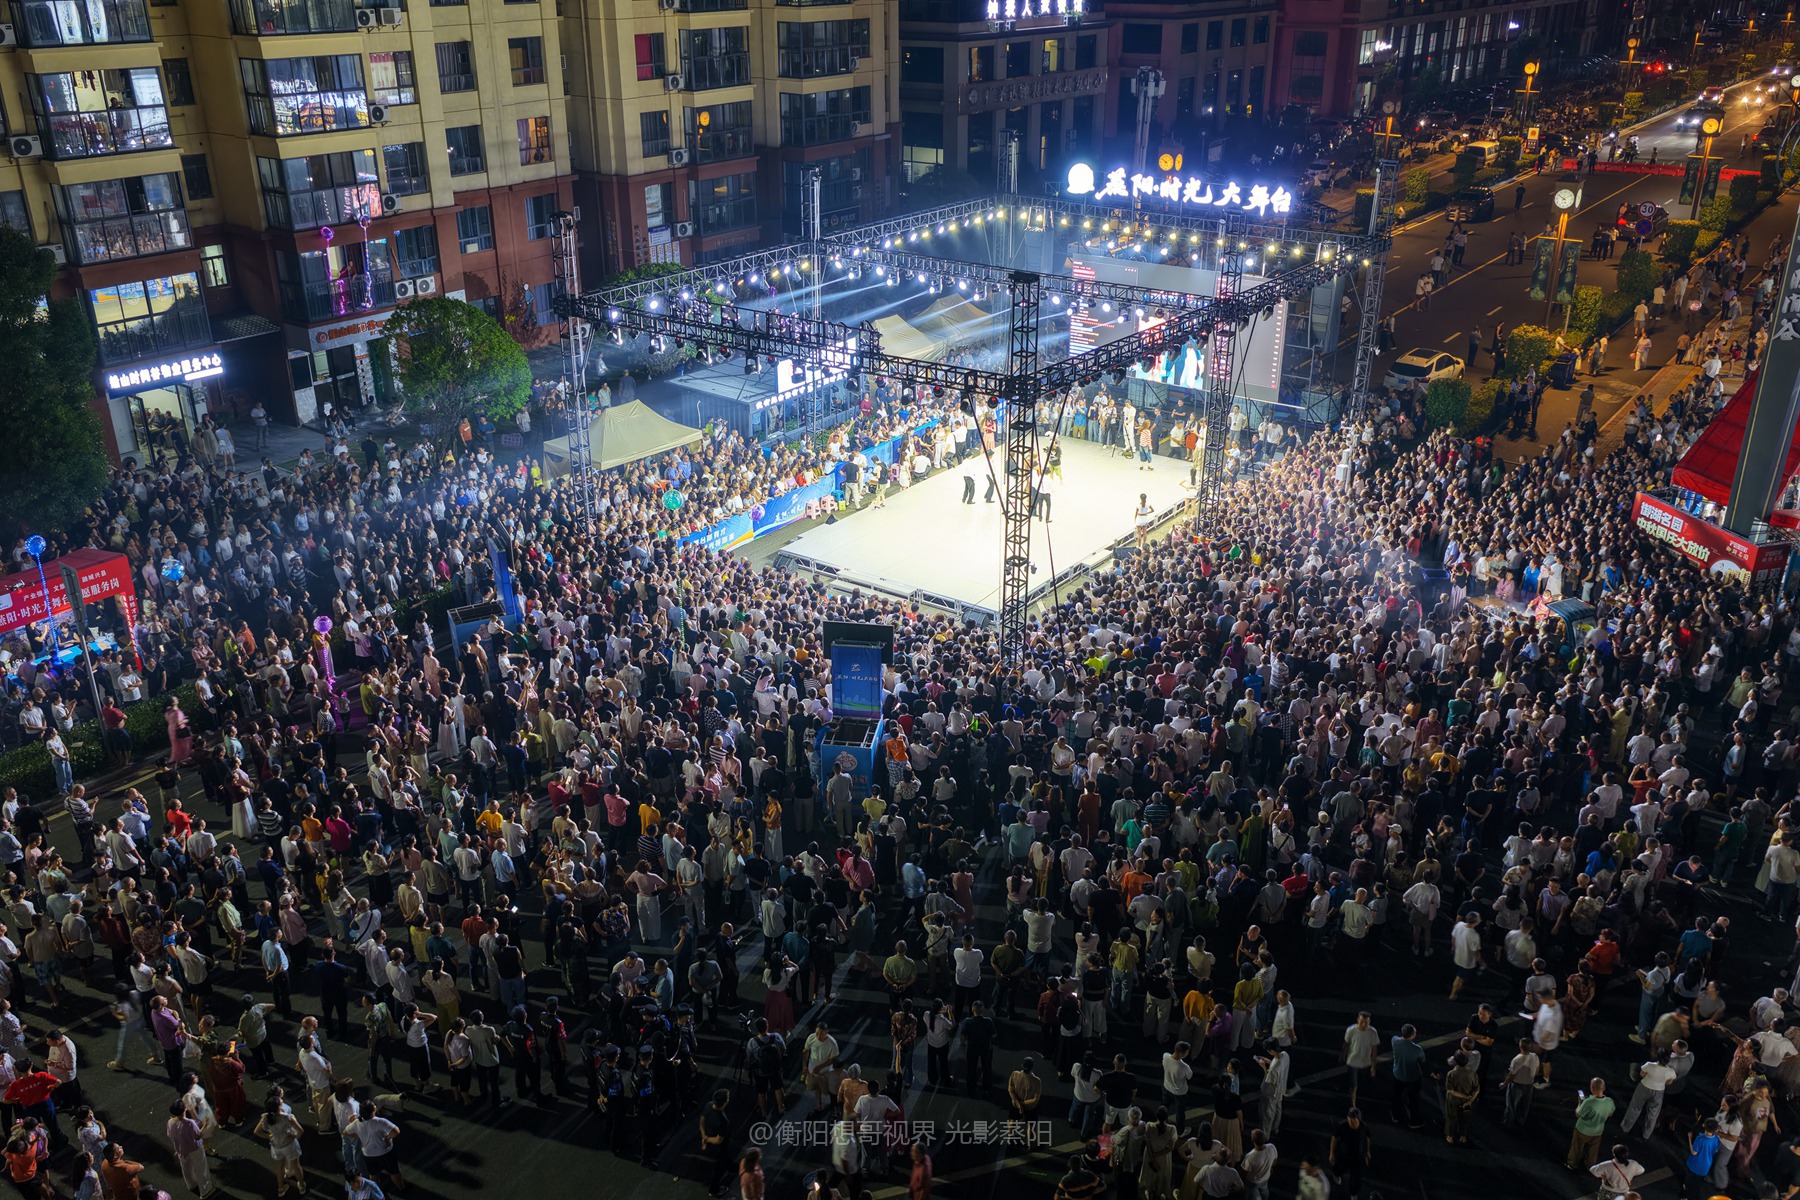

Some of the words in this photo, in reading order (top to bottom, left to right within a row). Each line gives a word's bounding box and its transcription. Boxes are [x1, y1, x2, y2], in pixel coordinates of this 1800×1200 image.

[1095, 167, 1293, 217] 蒸阳·时光大舞台
[1641, 204, 1653, 214] 30
[1636, 516, 1711, 563] 中秋国庆大放价
